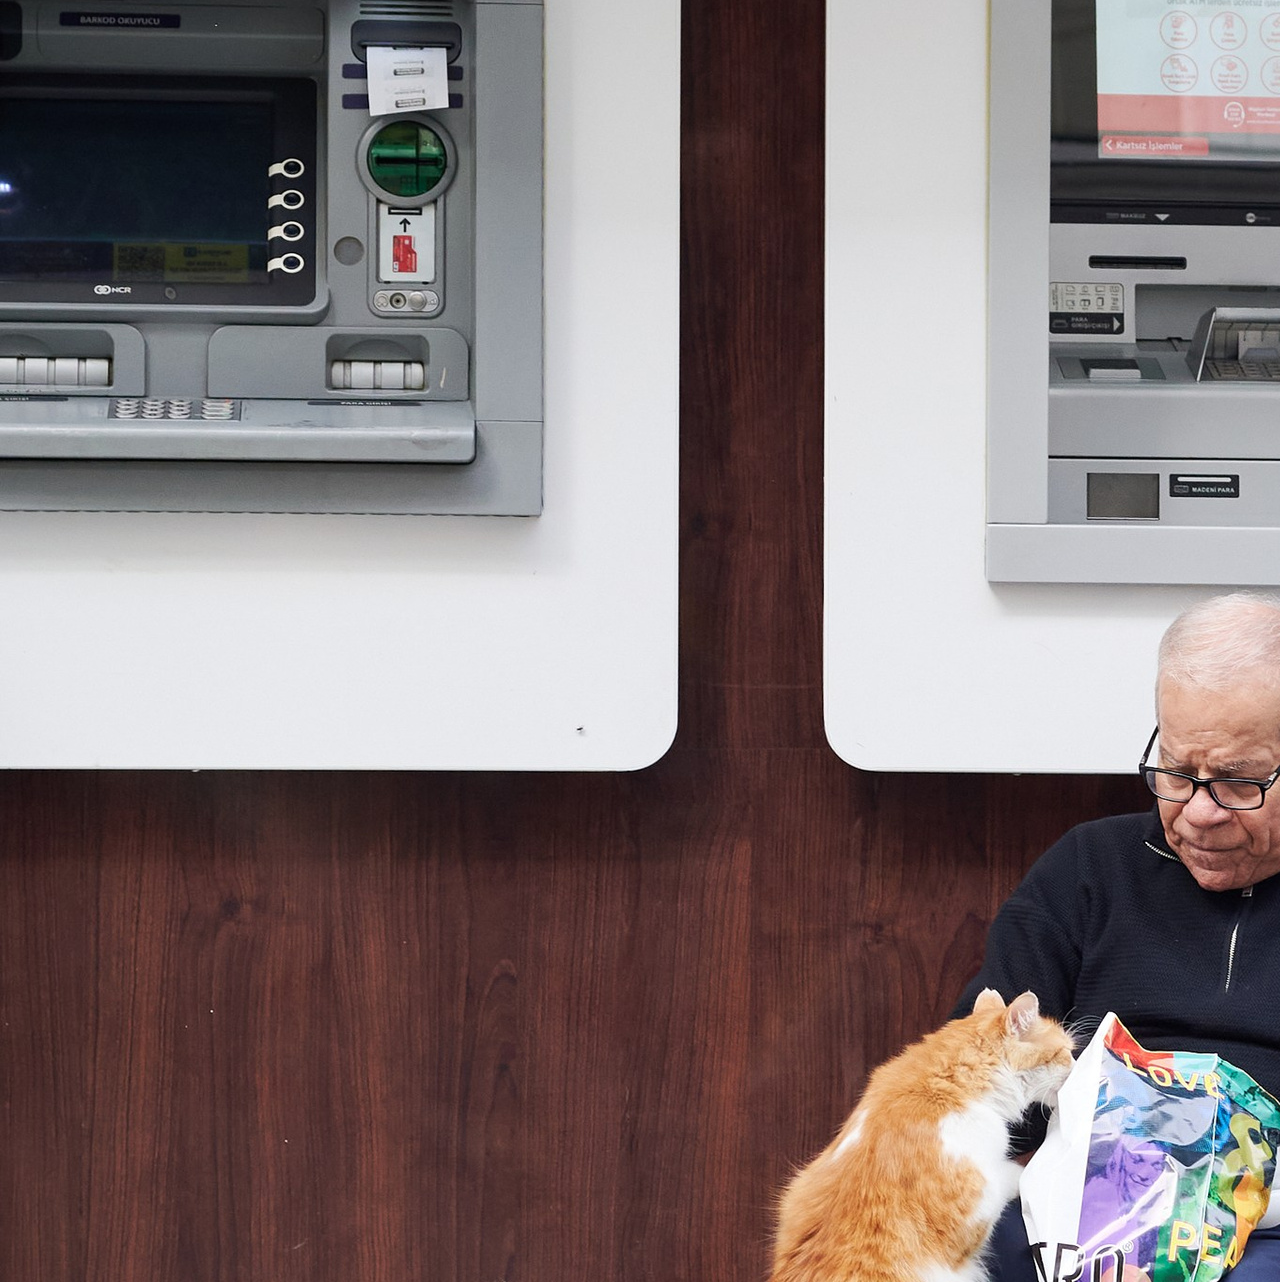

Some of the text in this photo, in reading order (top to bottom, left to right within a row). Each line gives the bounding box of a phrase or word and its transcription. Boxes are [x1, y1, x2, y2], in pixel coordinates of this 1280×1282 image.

[1115, 141, 1147, 151] Kartsız
[111, 286, 132, 294] NCR
[1192, 486, 1235, 495] MADENİ PARA
[1122, 1052, 1225, 1100] LOVE
